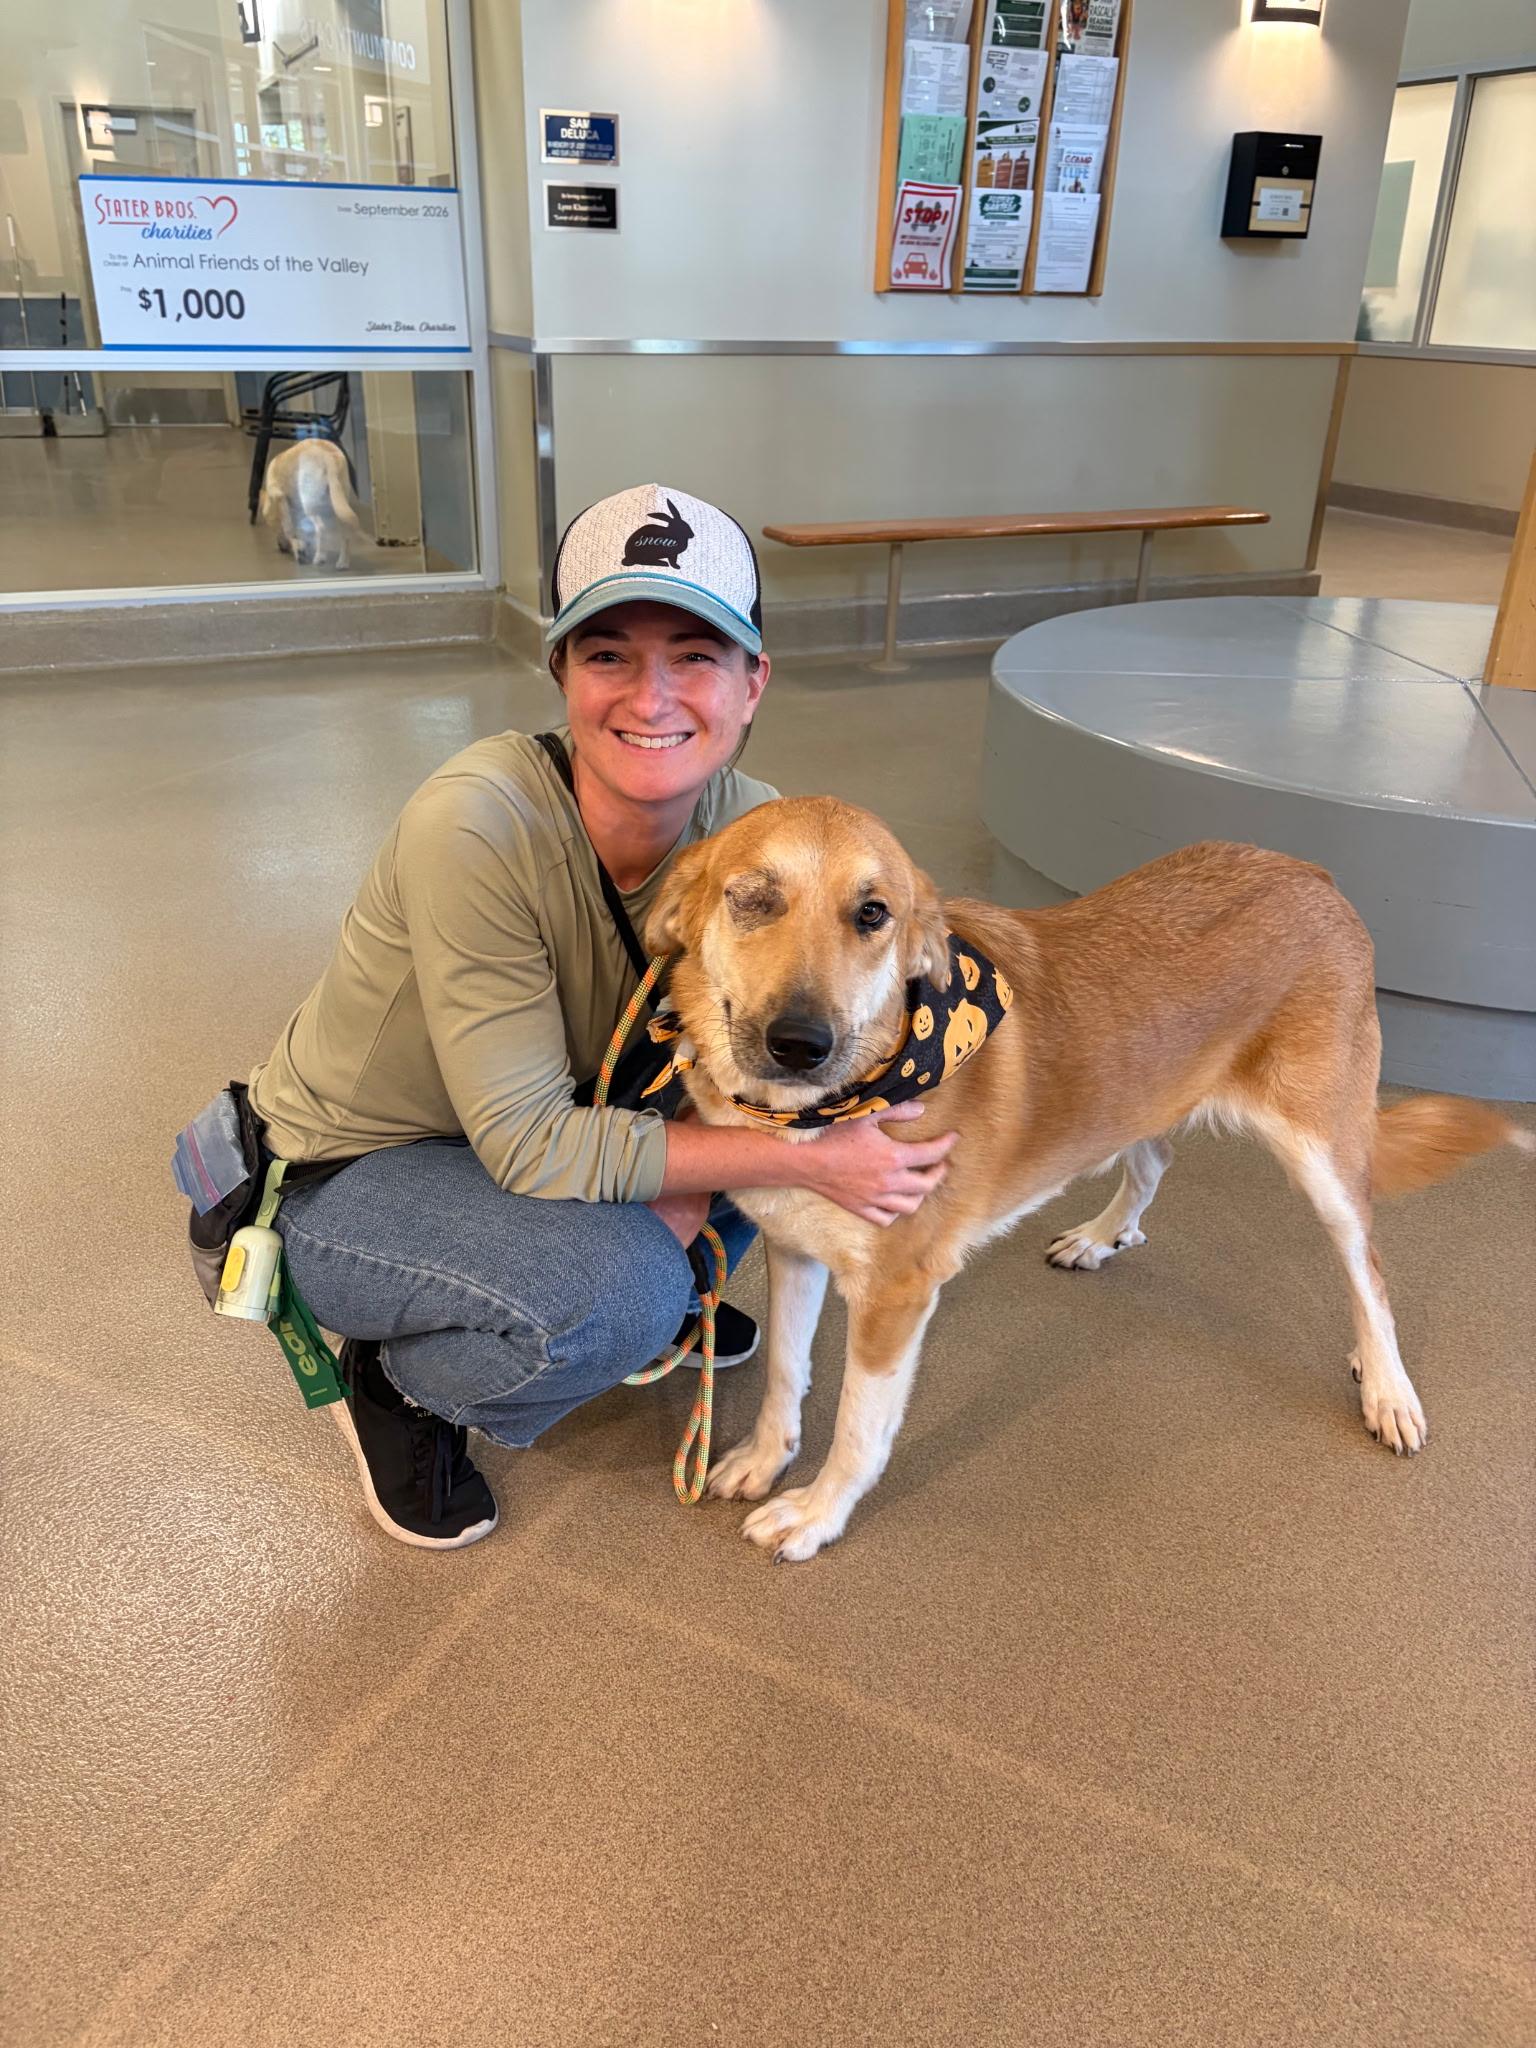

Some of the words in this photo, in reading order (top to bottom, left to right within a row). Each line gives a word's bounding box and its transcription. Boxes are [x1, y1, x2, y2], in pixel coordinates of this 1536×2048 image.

[560, 128, 600, 140] DELUCA
[95, 193, 149, 224] STATER
[155, 201, 197, 219] BROS.
[354, 203, 419, 217] September
[421, 205, 449, 217] 2026
[903, 207, 949, 225] STOP!
[141, 222, 213, 240] charities
[133, 253, 195, 270] Animal
[199, 253, 259, 271] Friends
[263, 256, 281, 271] of
[286, 256, 313, 272] the
[317, 257, 369, 277] Valley
[138, 287, 245, 322] $1,000
[634, 535, 679, 547] snow
